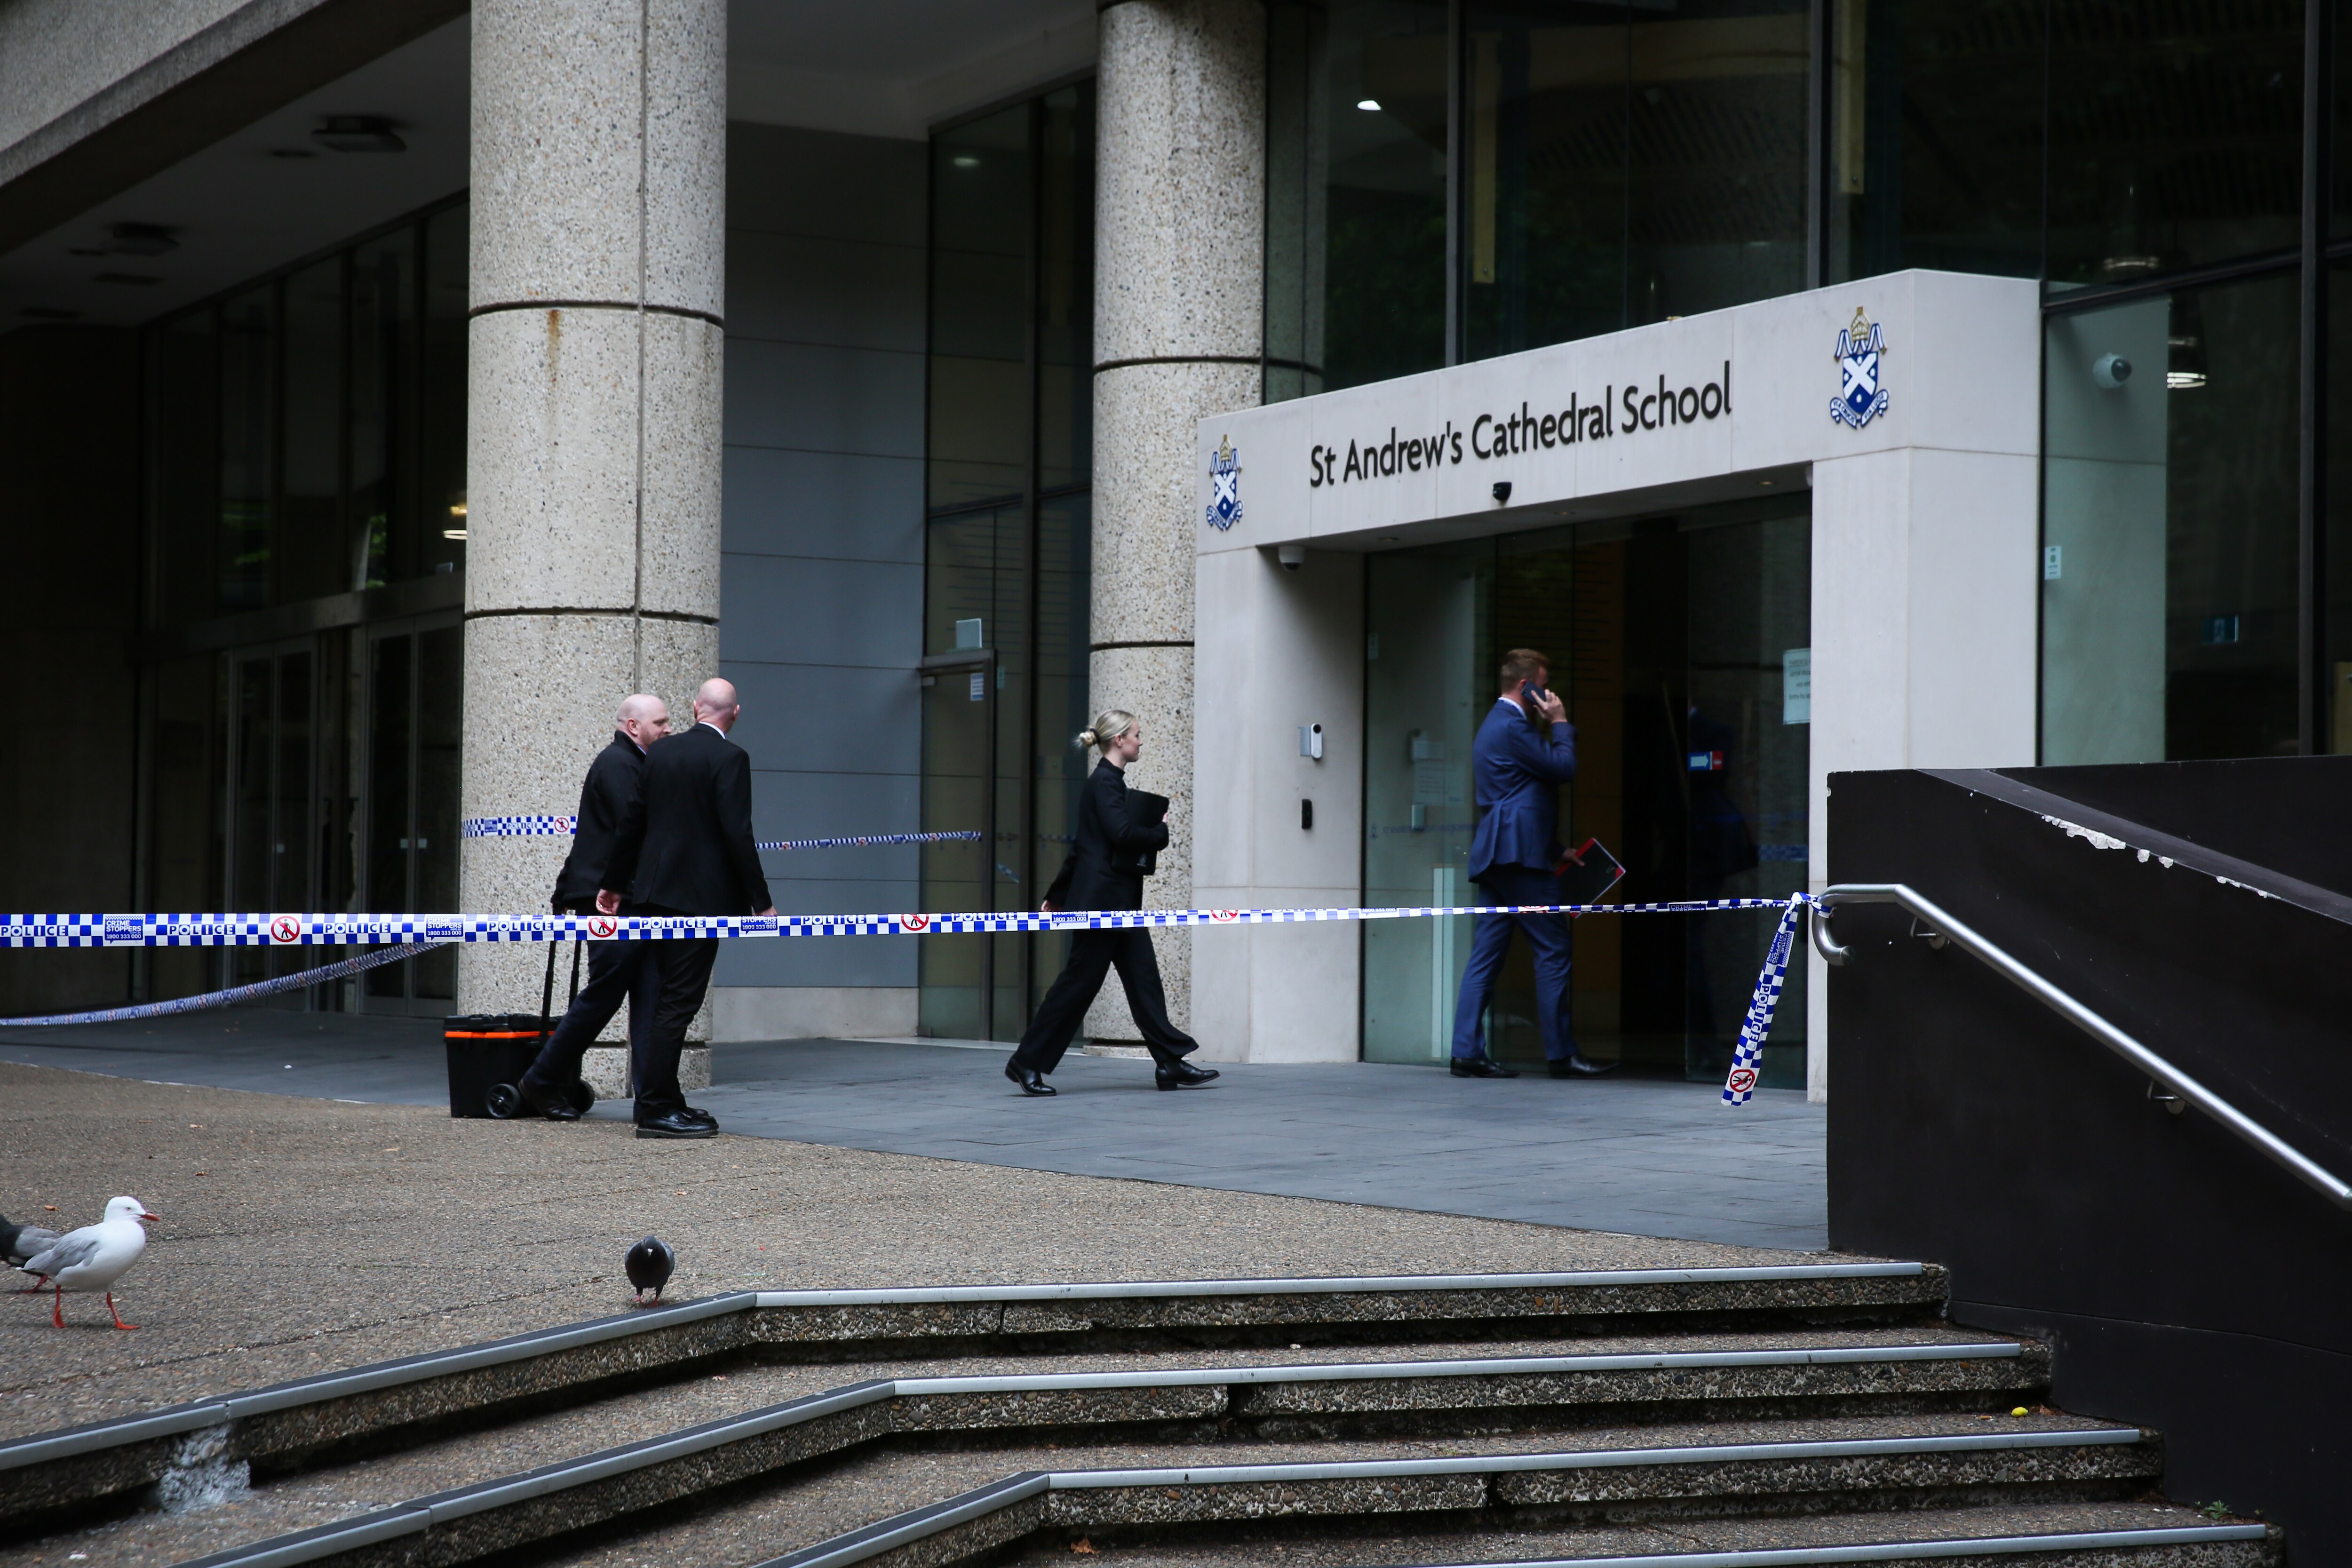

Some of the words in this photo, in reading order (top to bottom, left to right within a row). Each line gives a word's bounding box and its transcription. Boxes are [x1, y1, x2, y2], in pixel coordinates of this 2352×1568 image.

[1310, 445, 1336, 488] St
[1343, 421, 1462, 483] Andrew's
[1472, 385, 1613, 460] Cathedral
[1621, 360, 1732, 434] School
[642, 918, 704, 928] POLICE
[803, 915, 865, 925] POLICE
[1, 925, 66, 936] POLICE
[169, 925, 233, 935] POLICE
[325, 923, 389, 933] POLICE
[489, 922, 552, 931] POLICE
[1749, 985, 1771, 1041] POLICE
